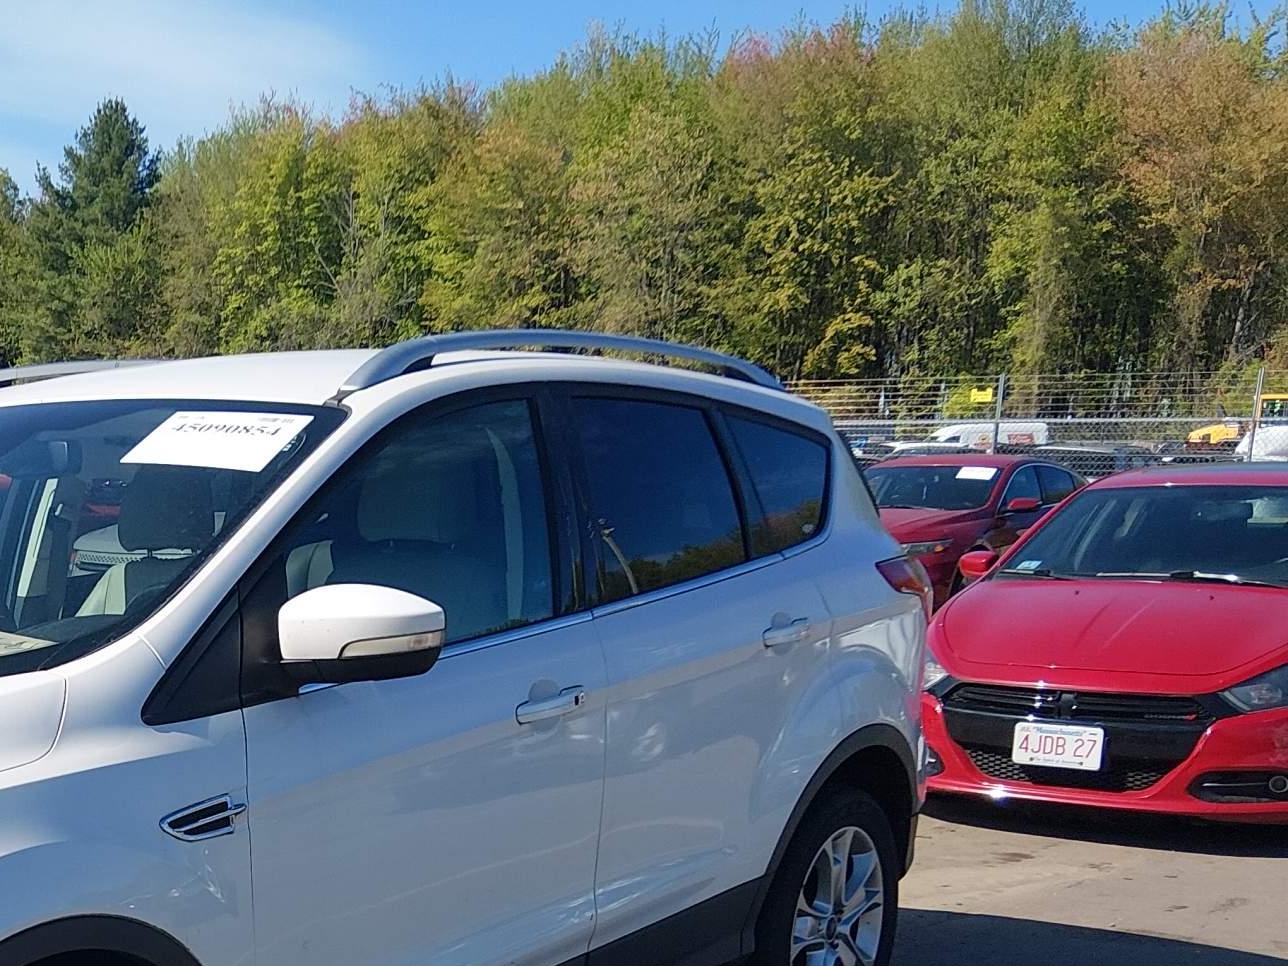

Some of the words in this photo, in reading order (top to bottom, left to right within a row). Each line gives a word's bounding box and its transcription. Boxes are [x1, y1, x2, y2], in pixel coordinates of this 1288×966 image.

[172, 423, 282, 437] 45090854
[1019, 734, 1067, 756] 4JDB
[1073, 738, 1098, 759] 27
